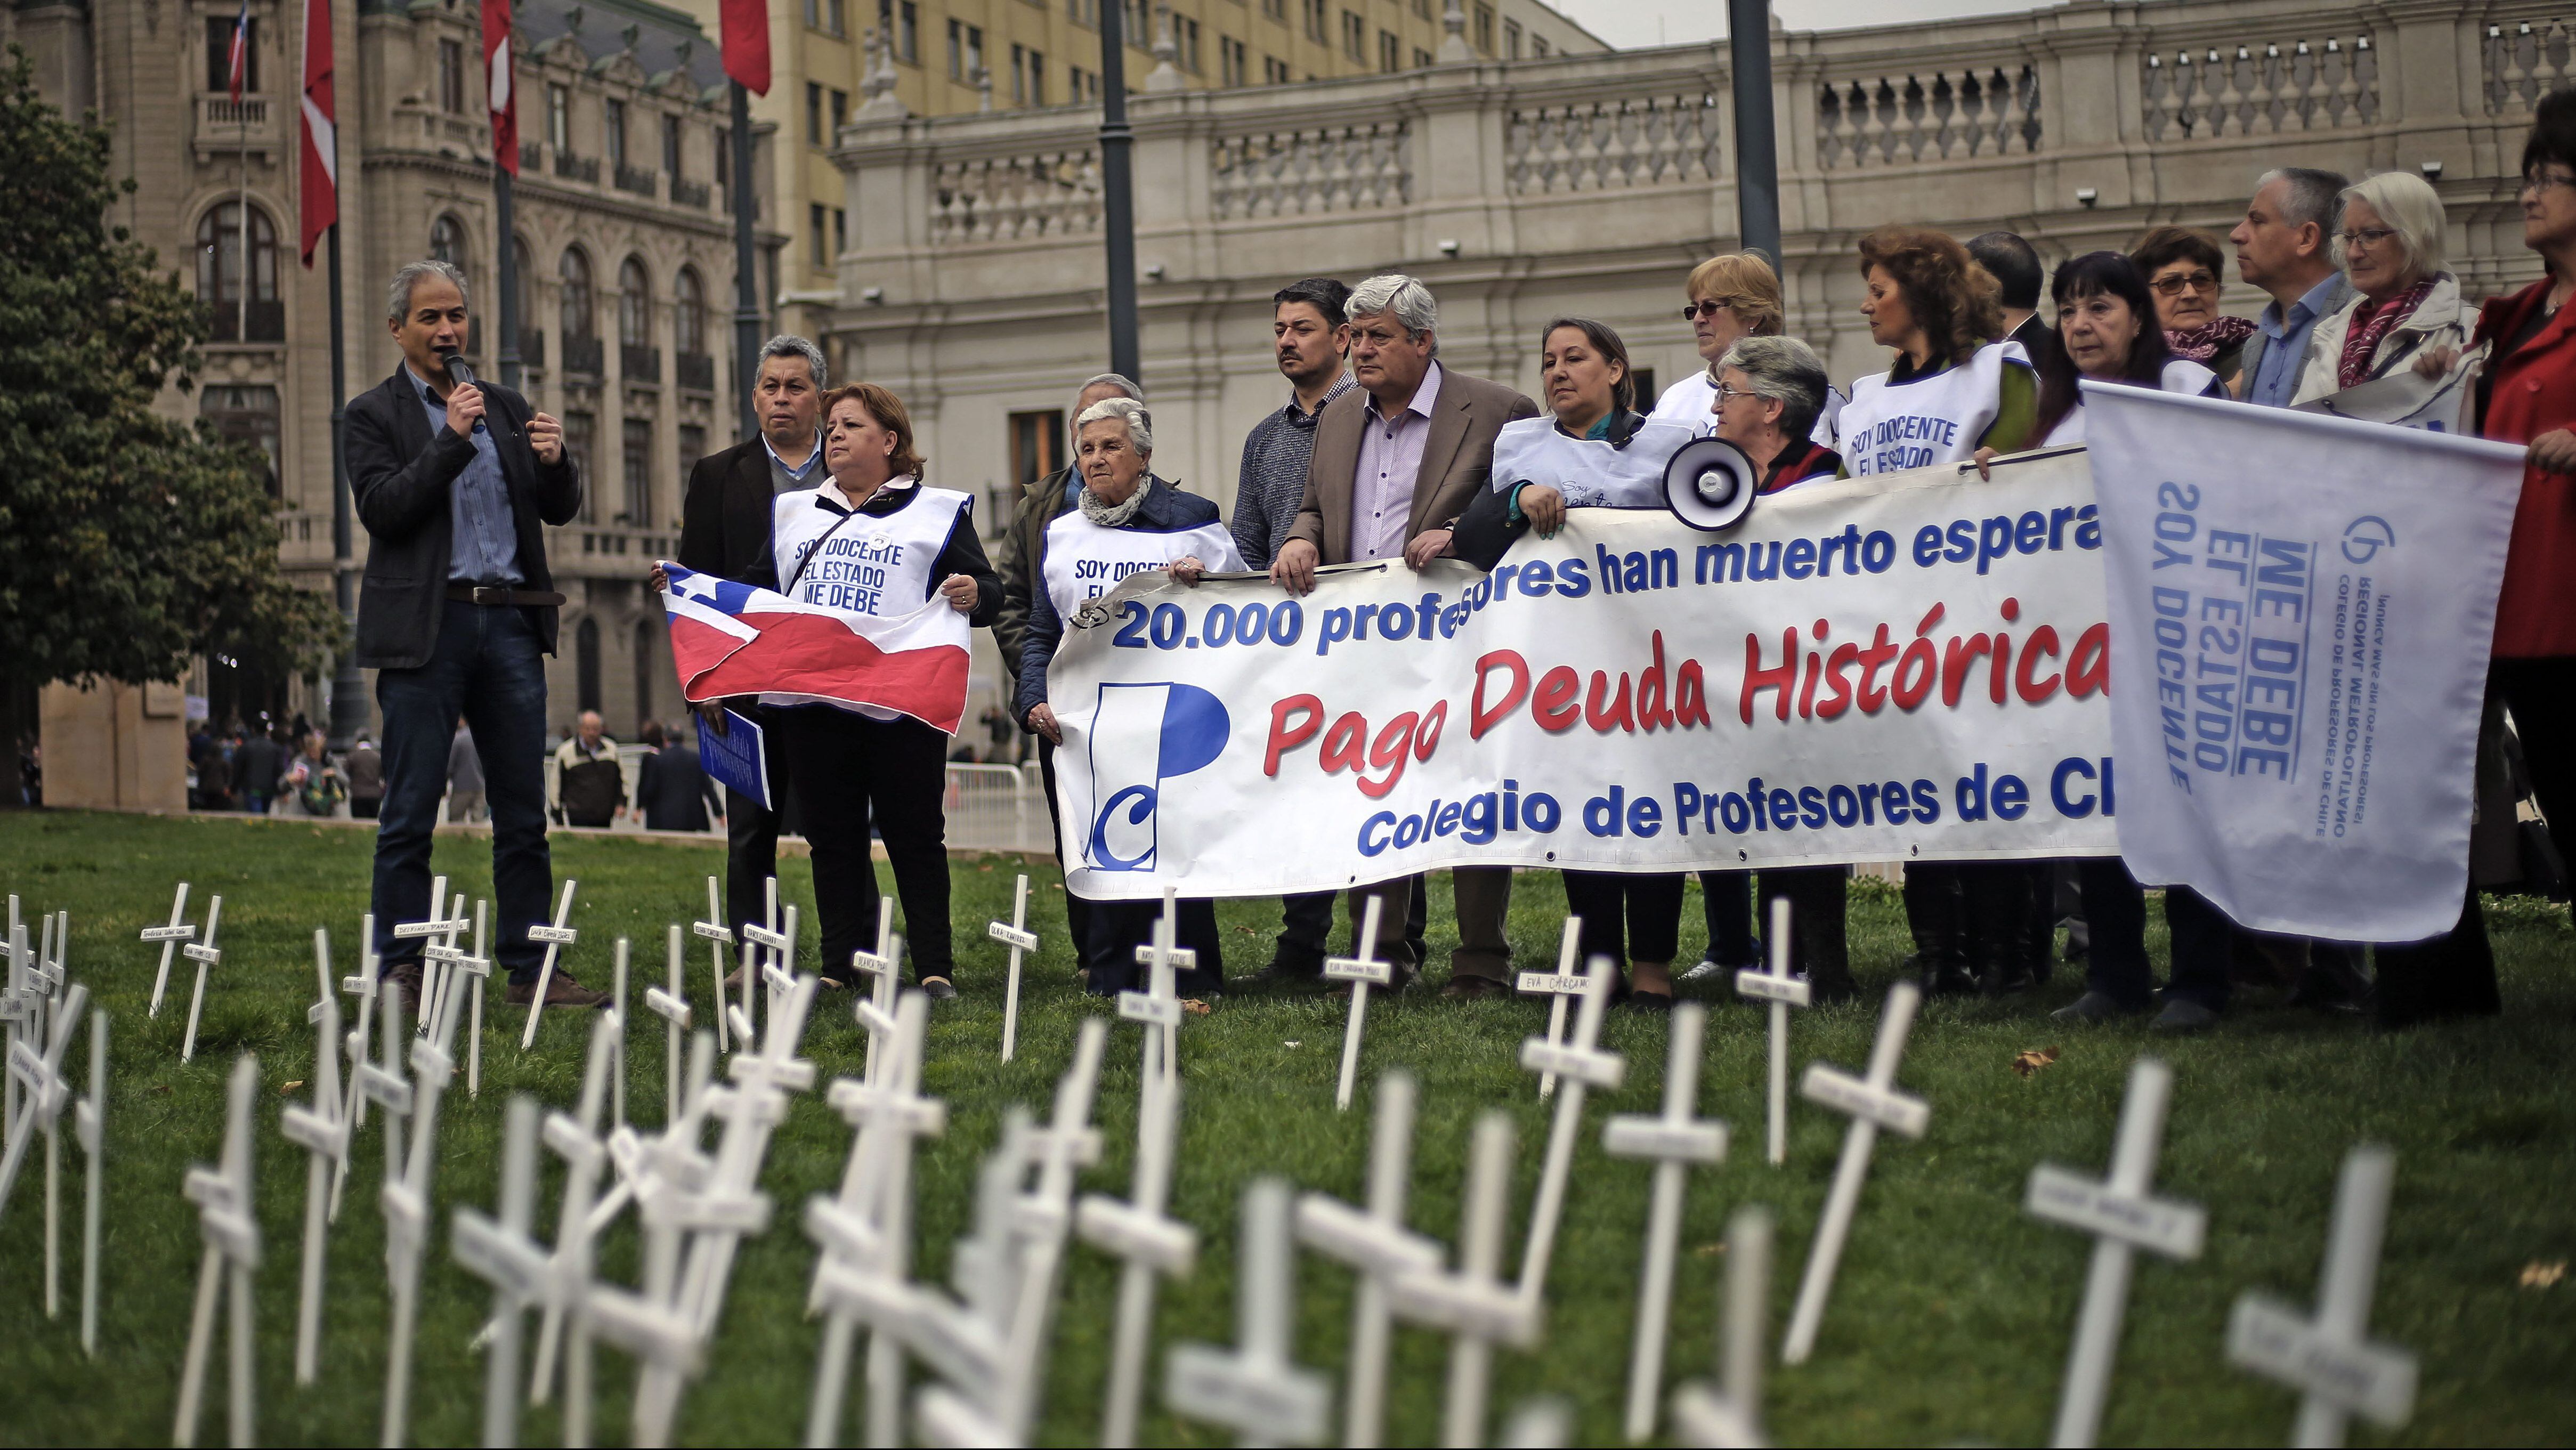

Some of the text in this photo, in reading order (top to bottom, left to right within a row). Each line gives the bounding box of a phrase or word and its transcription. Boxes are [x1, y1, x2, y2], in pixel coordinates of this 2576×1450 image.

[1851, 415, 1958, 456] SOY DOCENTE
[825, 538, 904, 566] DOCENTE
[805, 561, 885, 588] EL ESTADO
[1075, 560, 1111, 579] SOY
[804, 584, 881, 615] ME DEBE
[1112, 601, 1304, 650] 20.000
[1317, 557, 1591, 656] profesores
[1595, 543, 1678, 595] han
[1696, 523, 1897, 584] muerto
[1263, 597, 2109, 796] Pago Deuda Histórica
[1357, 778, 1560, 857] Colegio
[1582, 785, 1661, 837] de
[1673, 777, 1940, 835] Profesores
[1956, 763, 2029, 821] de
[1527, 976, 1541, 987] EVA
